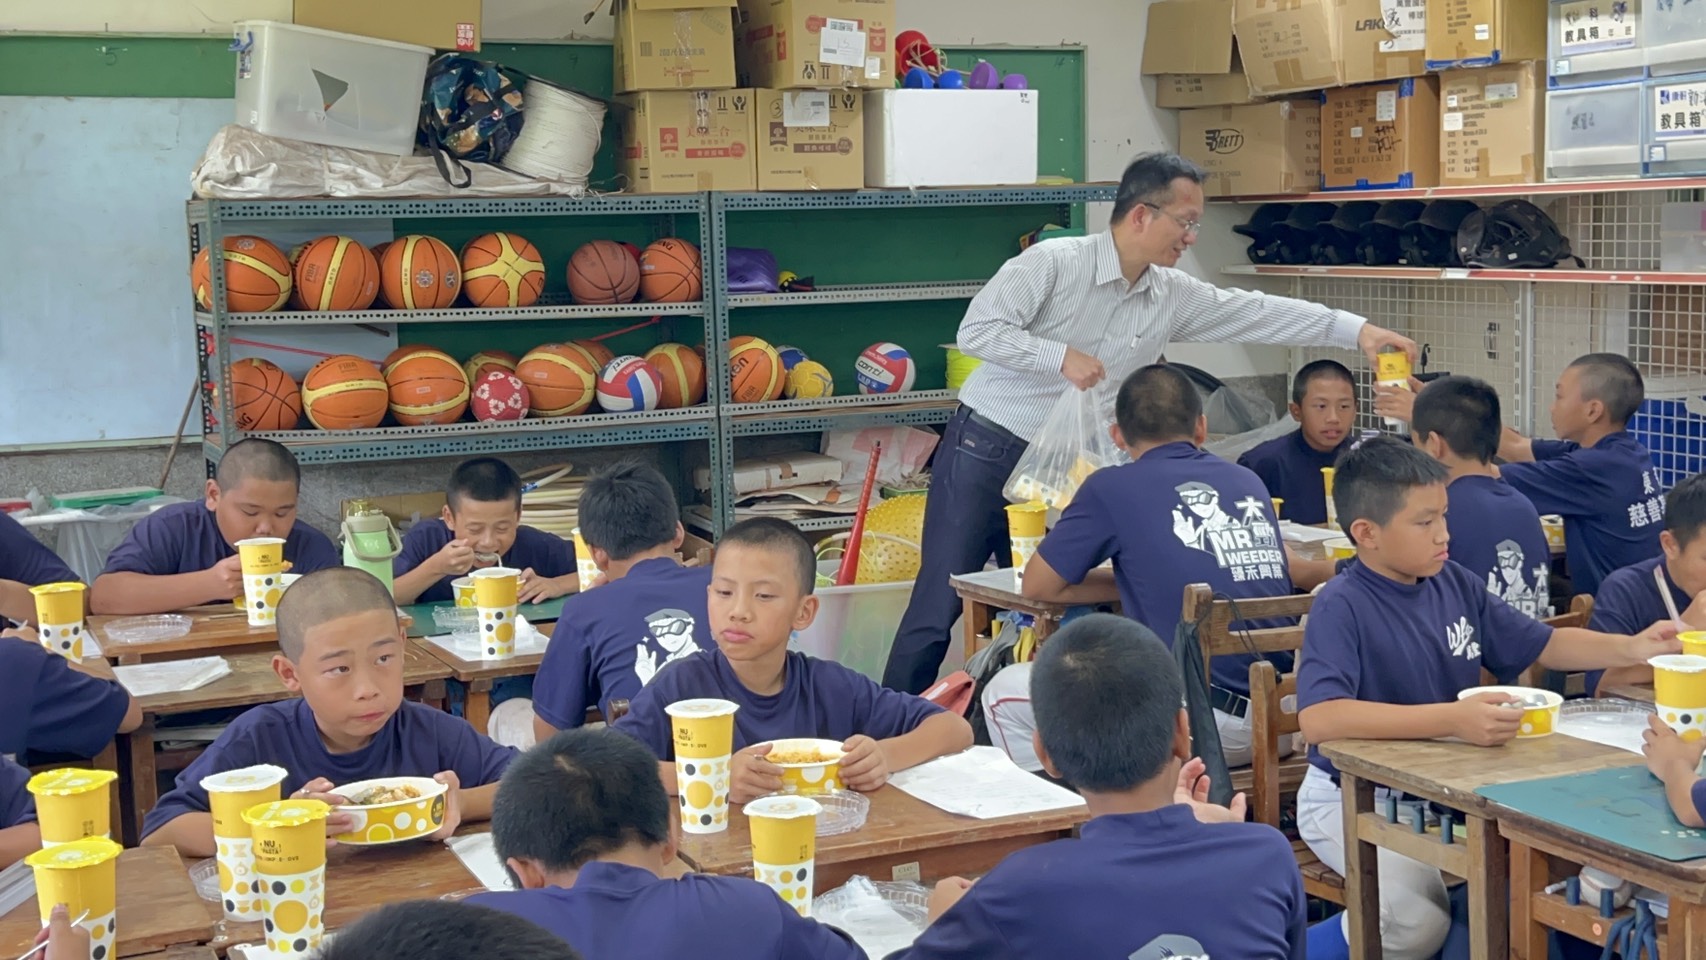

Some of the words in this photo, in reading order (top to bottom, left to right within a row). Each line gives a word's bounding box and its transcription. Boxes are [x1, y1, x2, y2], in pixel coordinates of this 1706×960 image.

[1355, 18, 1386, 31] LAK
[1565, 26, 1599, 43] 教具箱
[1661, 111, 1701, 130] 教具箱
[1205, 129, 1241, 152] BRETT
[1208, 529, 1253, 568] MR
[1226, 550, 1284, 566] WEEDER
[263, 840, 276, 848] NU
